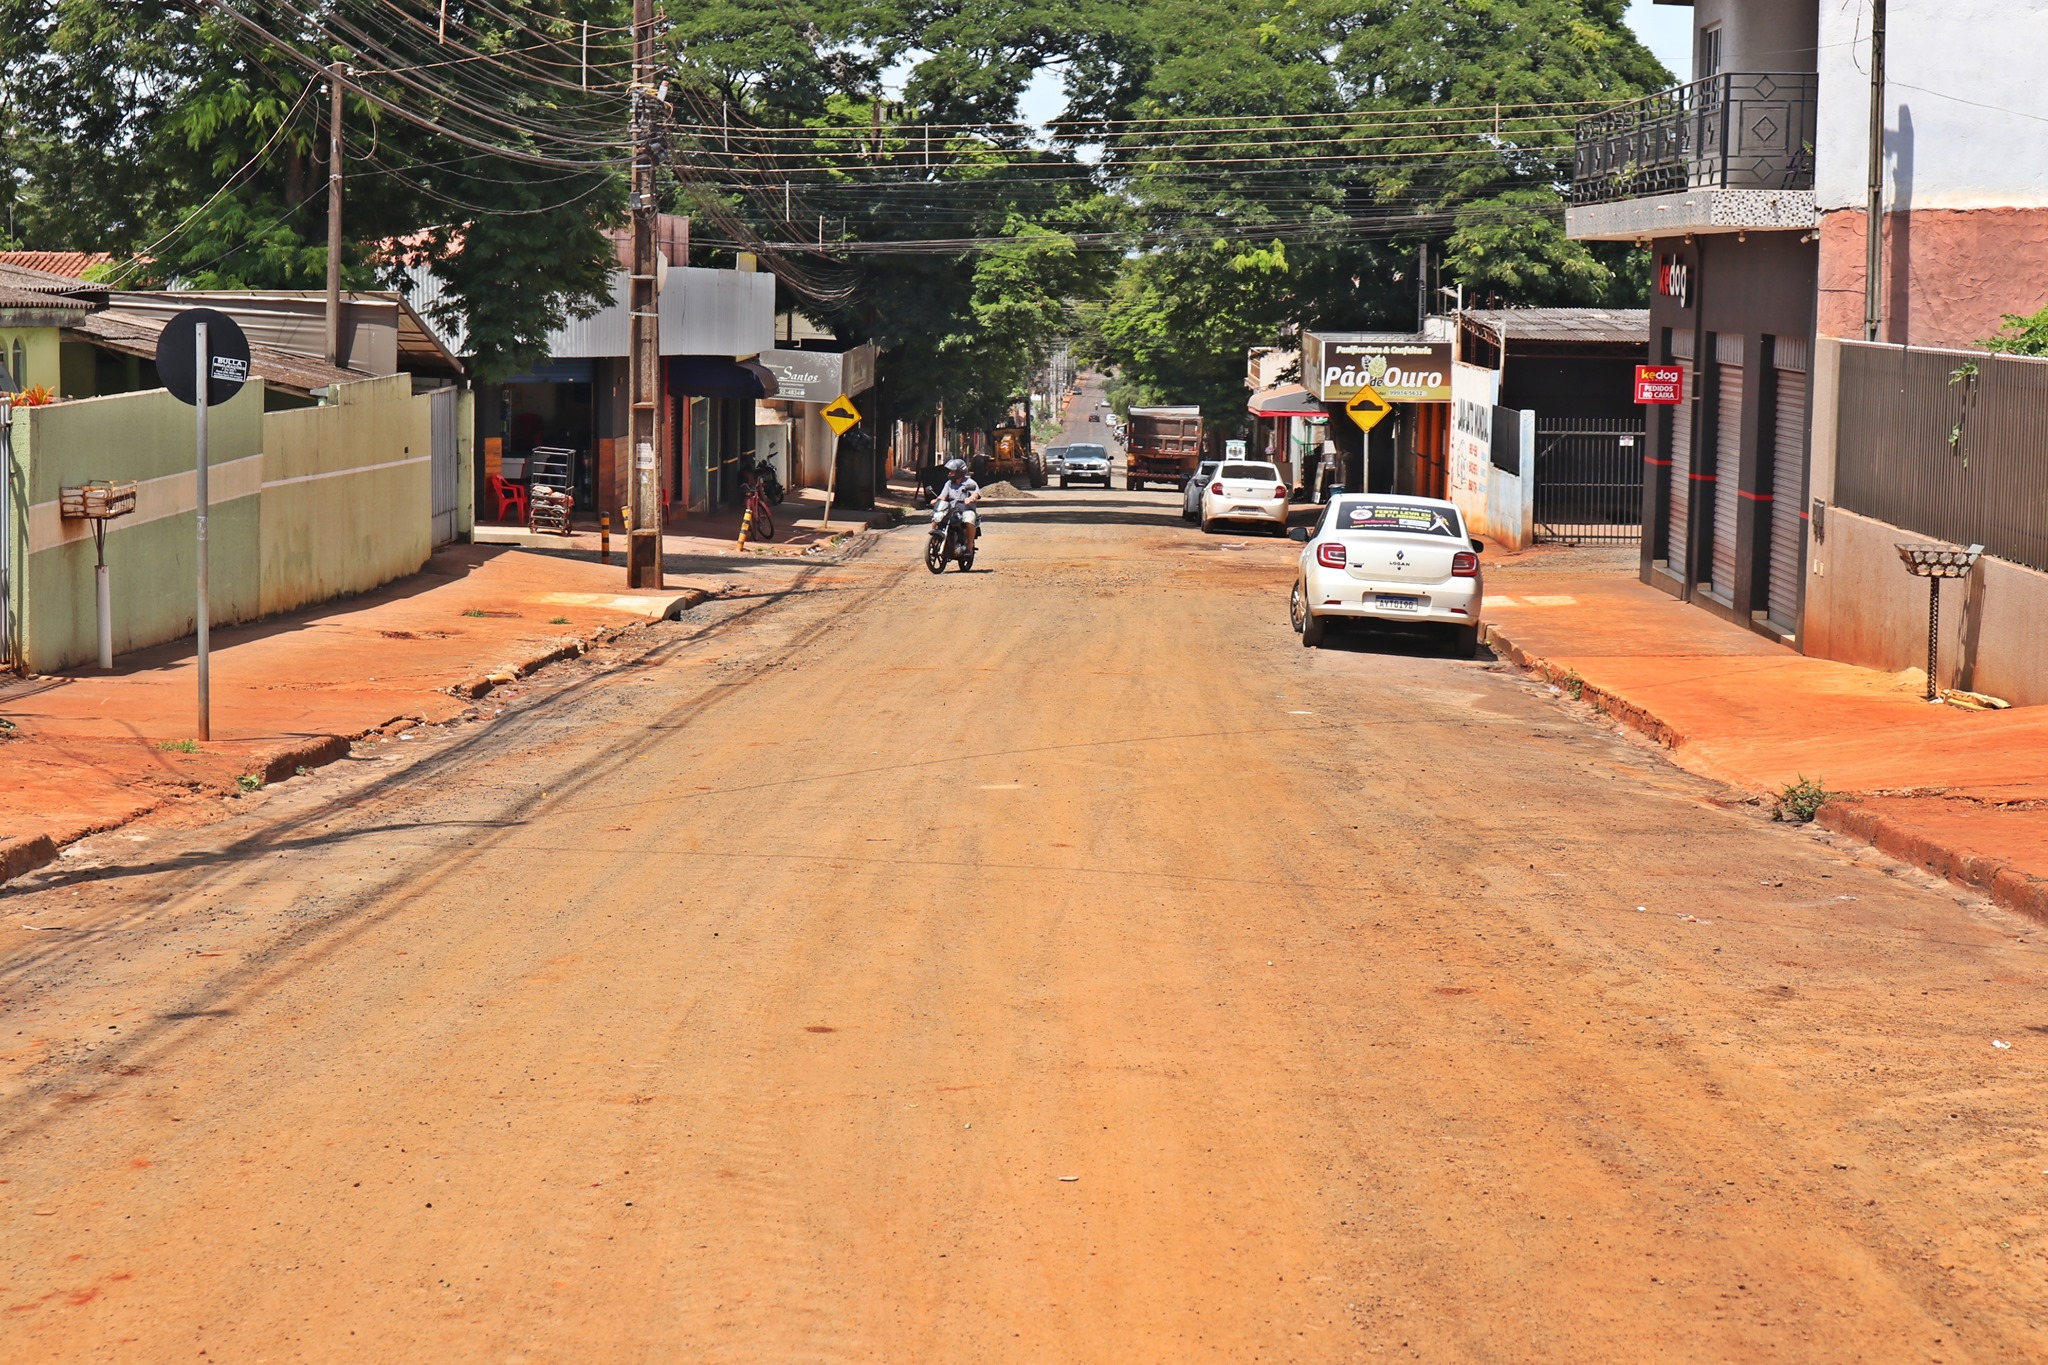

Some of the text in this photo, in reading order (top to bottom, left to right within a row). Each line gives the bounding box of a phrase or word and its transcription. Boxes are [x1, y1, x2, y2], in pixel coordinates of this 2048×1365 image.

[1658, 253, 1687, 308] kedog
[1336, 345, 1432, 356] Panificadora & Confeitaria
[217, 358, 242, 367] BULLA
[779, 365, 820, 383] Santos
[1325, 365, 1443, 388] Pão de Ouro
[1641, 368, 1679, 382] kedog
